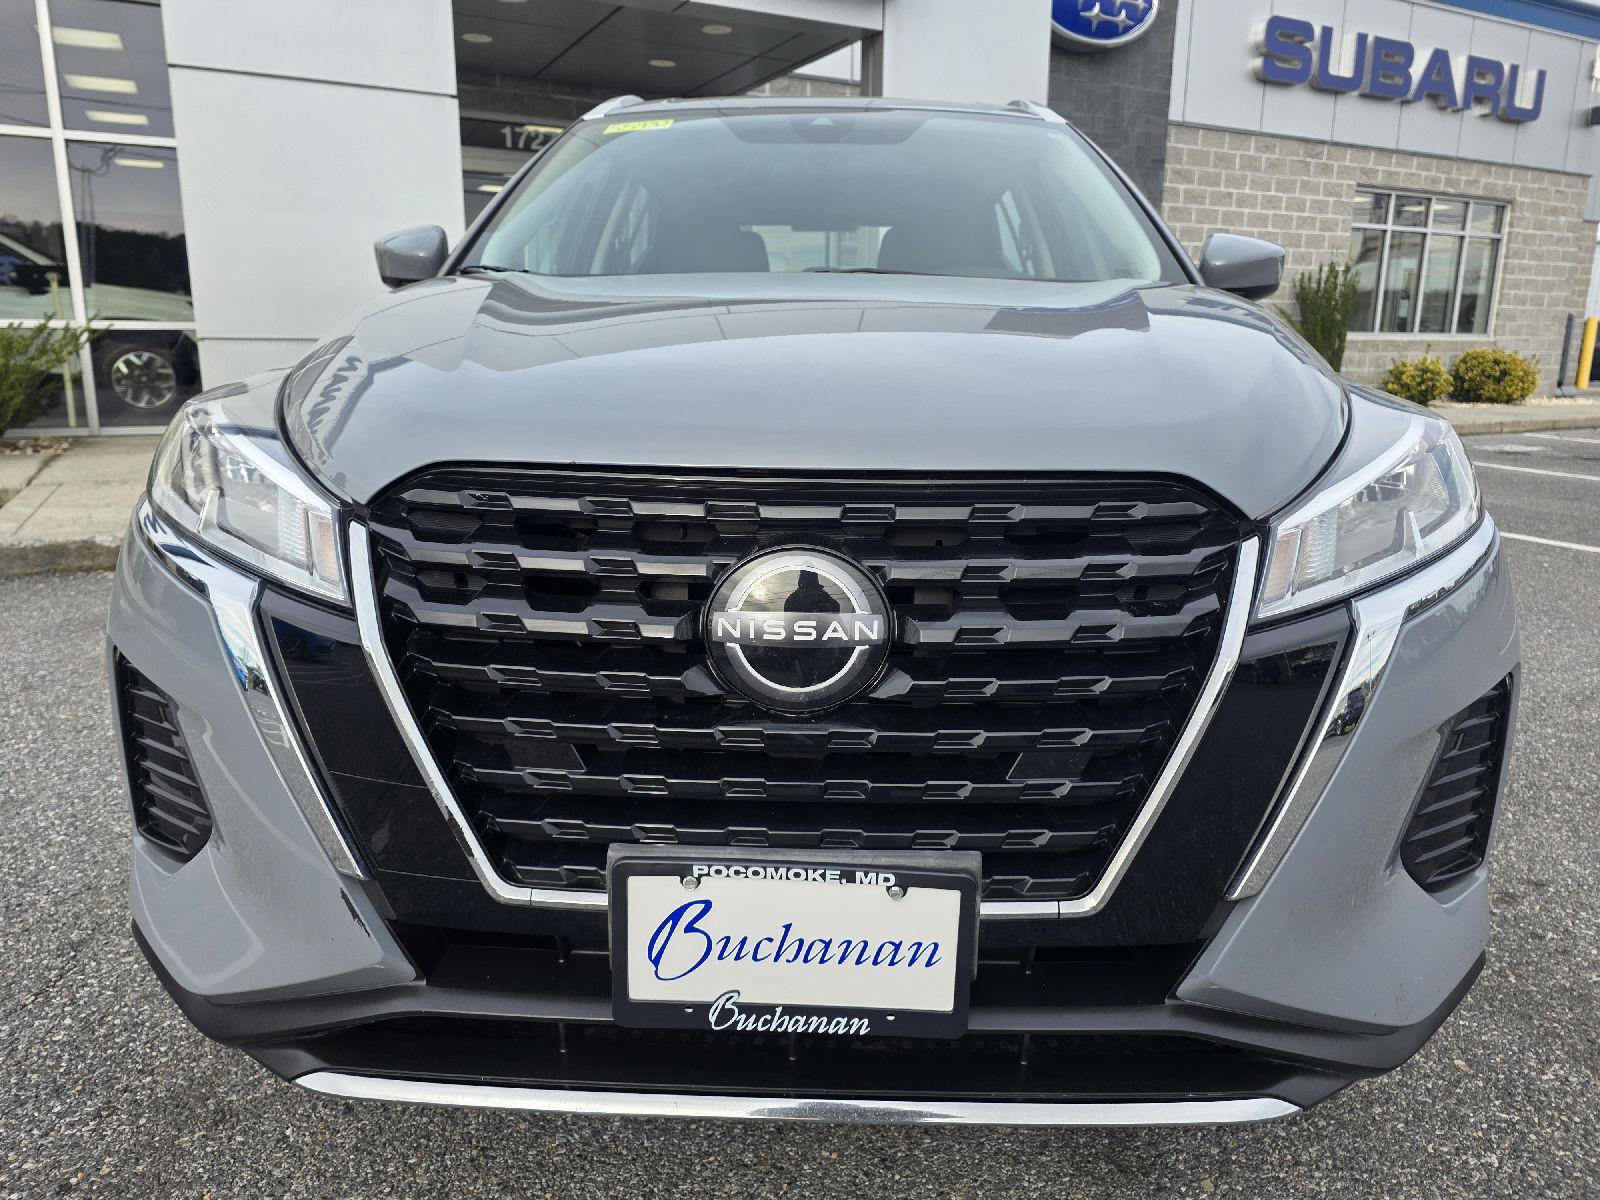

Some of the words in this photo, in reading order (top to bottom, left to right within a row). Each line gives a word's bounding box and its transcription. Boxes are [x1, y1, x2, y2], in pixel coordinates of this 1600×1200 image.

[1260, 15, 1548, 122] SUBARU
[717, 617, 879, 641] NISSAN
[692, 864, 847, 886] POCOMOKE,
[855, 871, 896, 887] MD
[647, 898, 943, 982] Buchanan
[708, 989, 871, 1036] Buchanan
